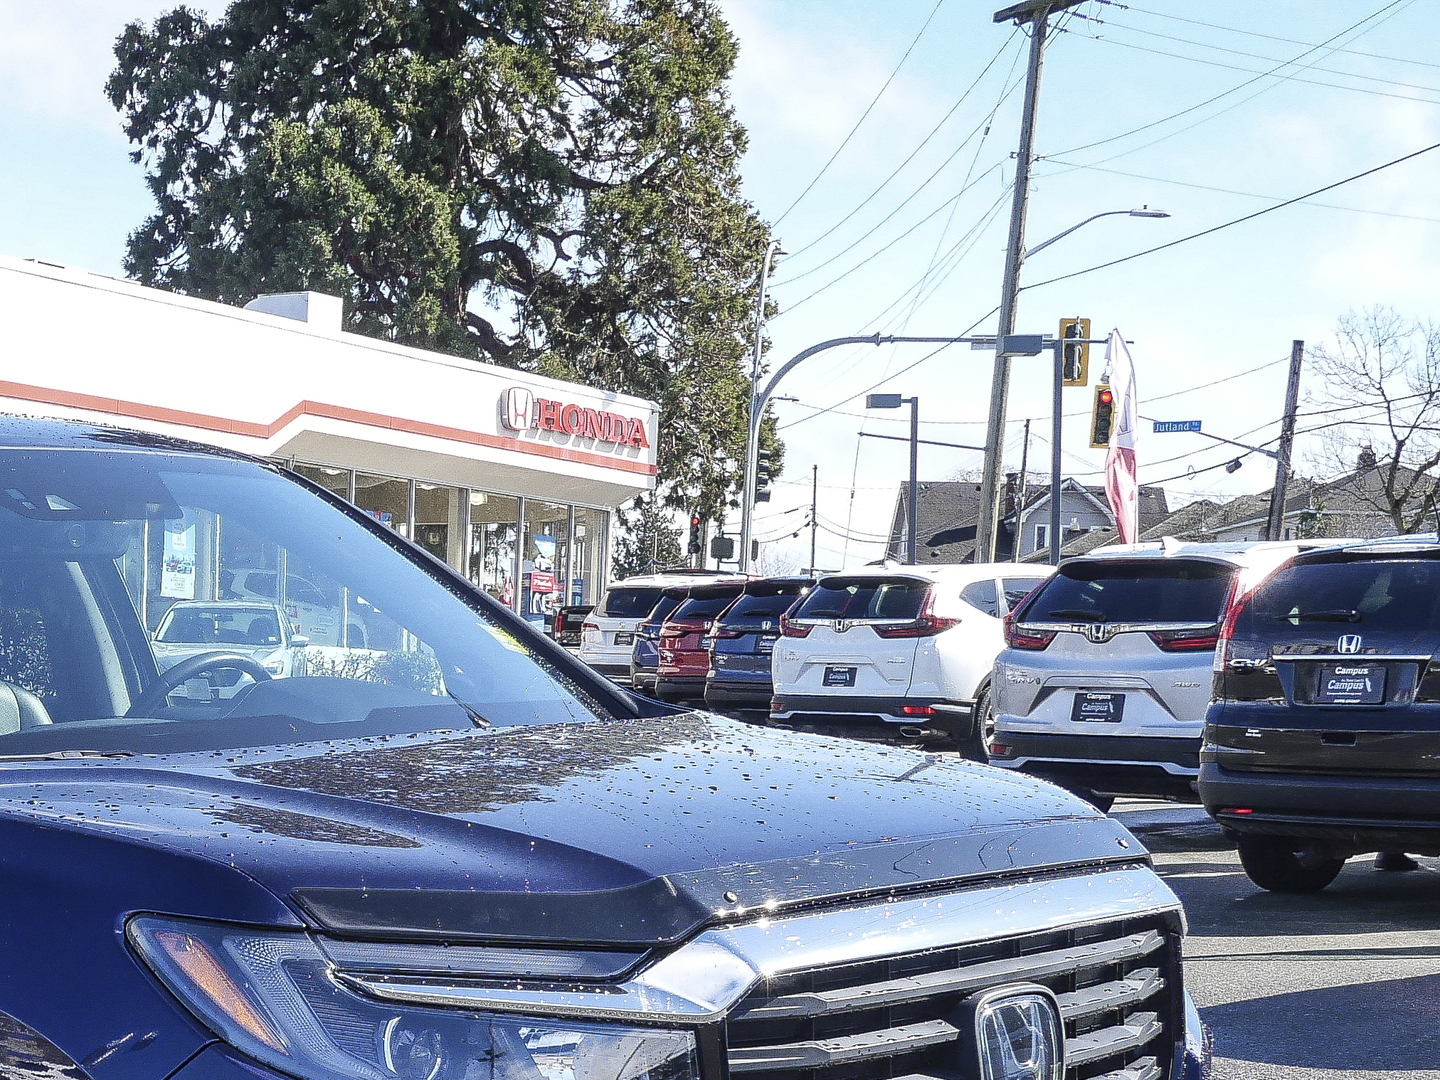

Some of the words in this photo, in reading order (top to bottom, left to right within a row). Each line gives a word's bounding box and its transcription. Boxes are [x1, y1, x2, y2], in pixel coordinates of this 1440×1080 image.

[537, 398, 650, 449] HONDA
[1155, 421, 1190, 432] Jutland
[1334, 666, 1369, 676] Campus
[1327, 679, 1365, 692] Campus
[1081, 702, 1109, 713] Campus
